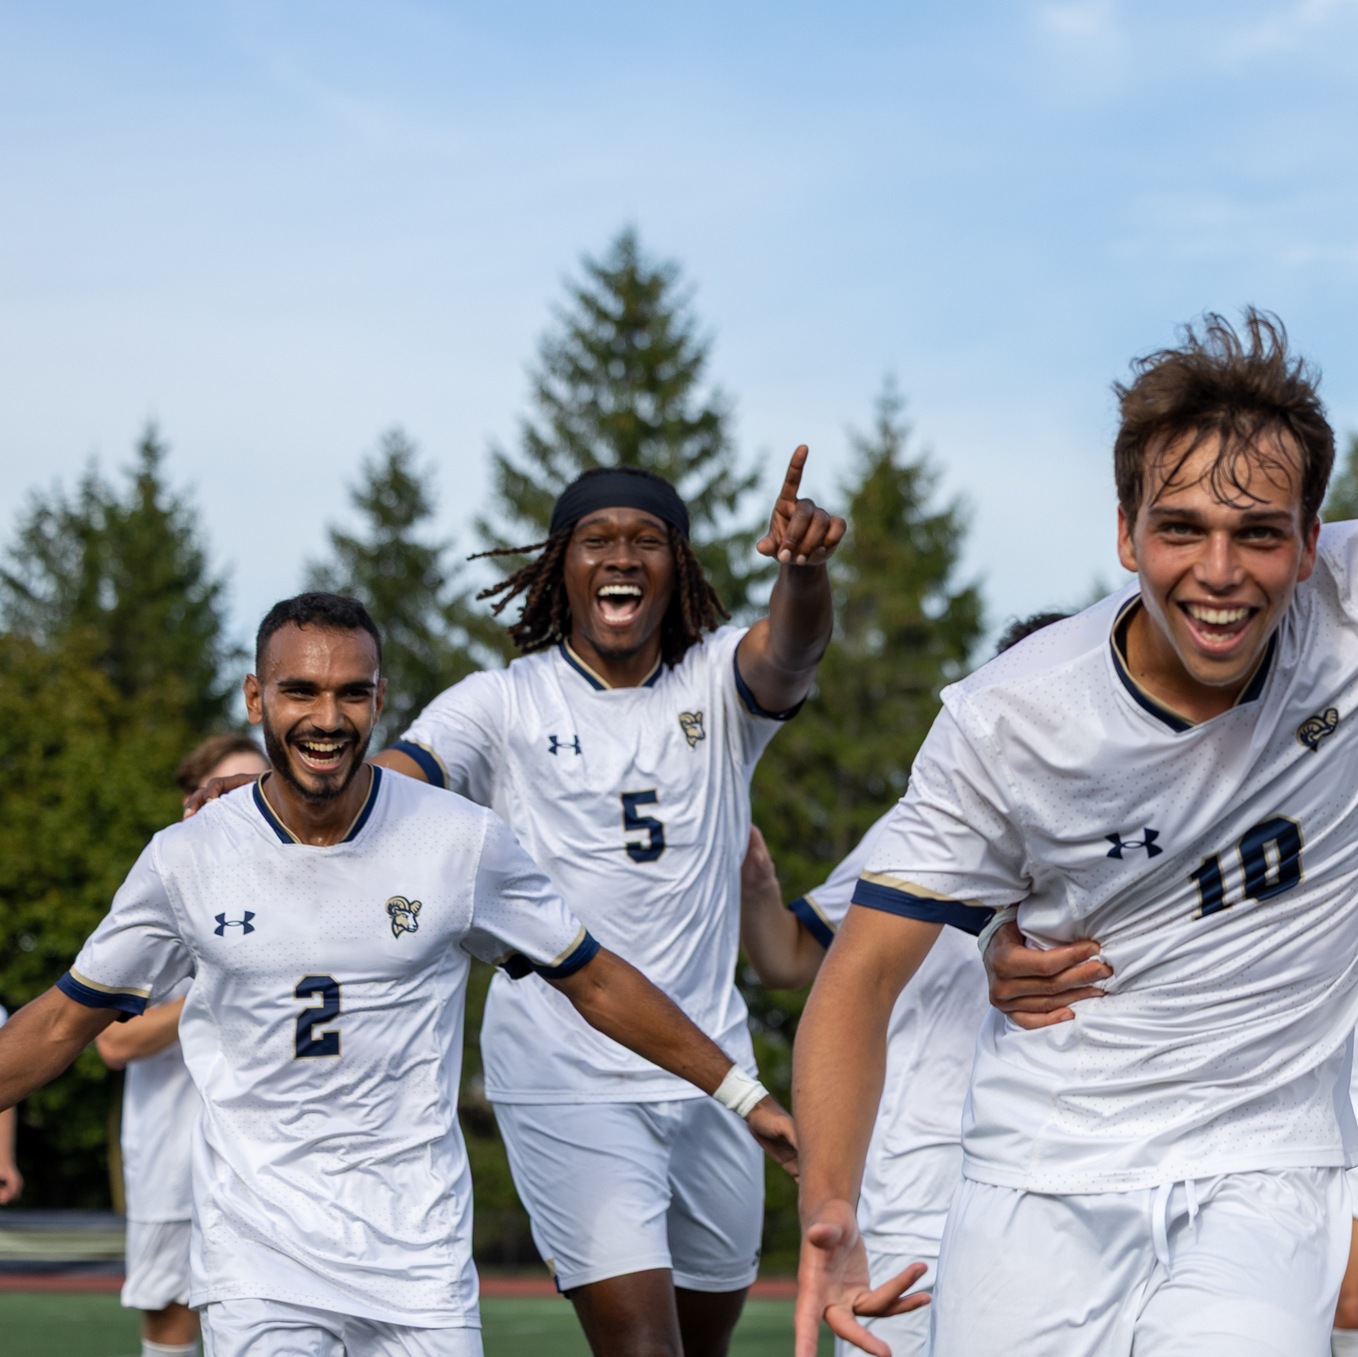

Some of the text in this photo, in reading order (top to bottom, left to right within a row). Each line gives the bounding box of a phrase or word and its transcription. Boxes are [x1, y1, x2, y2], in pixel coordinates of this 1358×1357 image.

[621, 790, 665, 863] 5
[1189, 815, 1304, 920] 10
[293, 975, 340, 1059] 2
